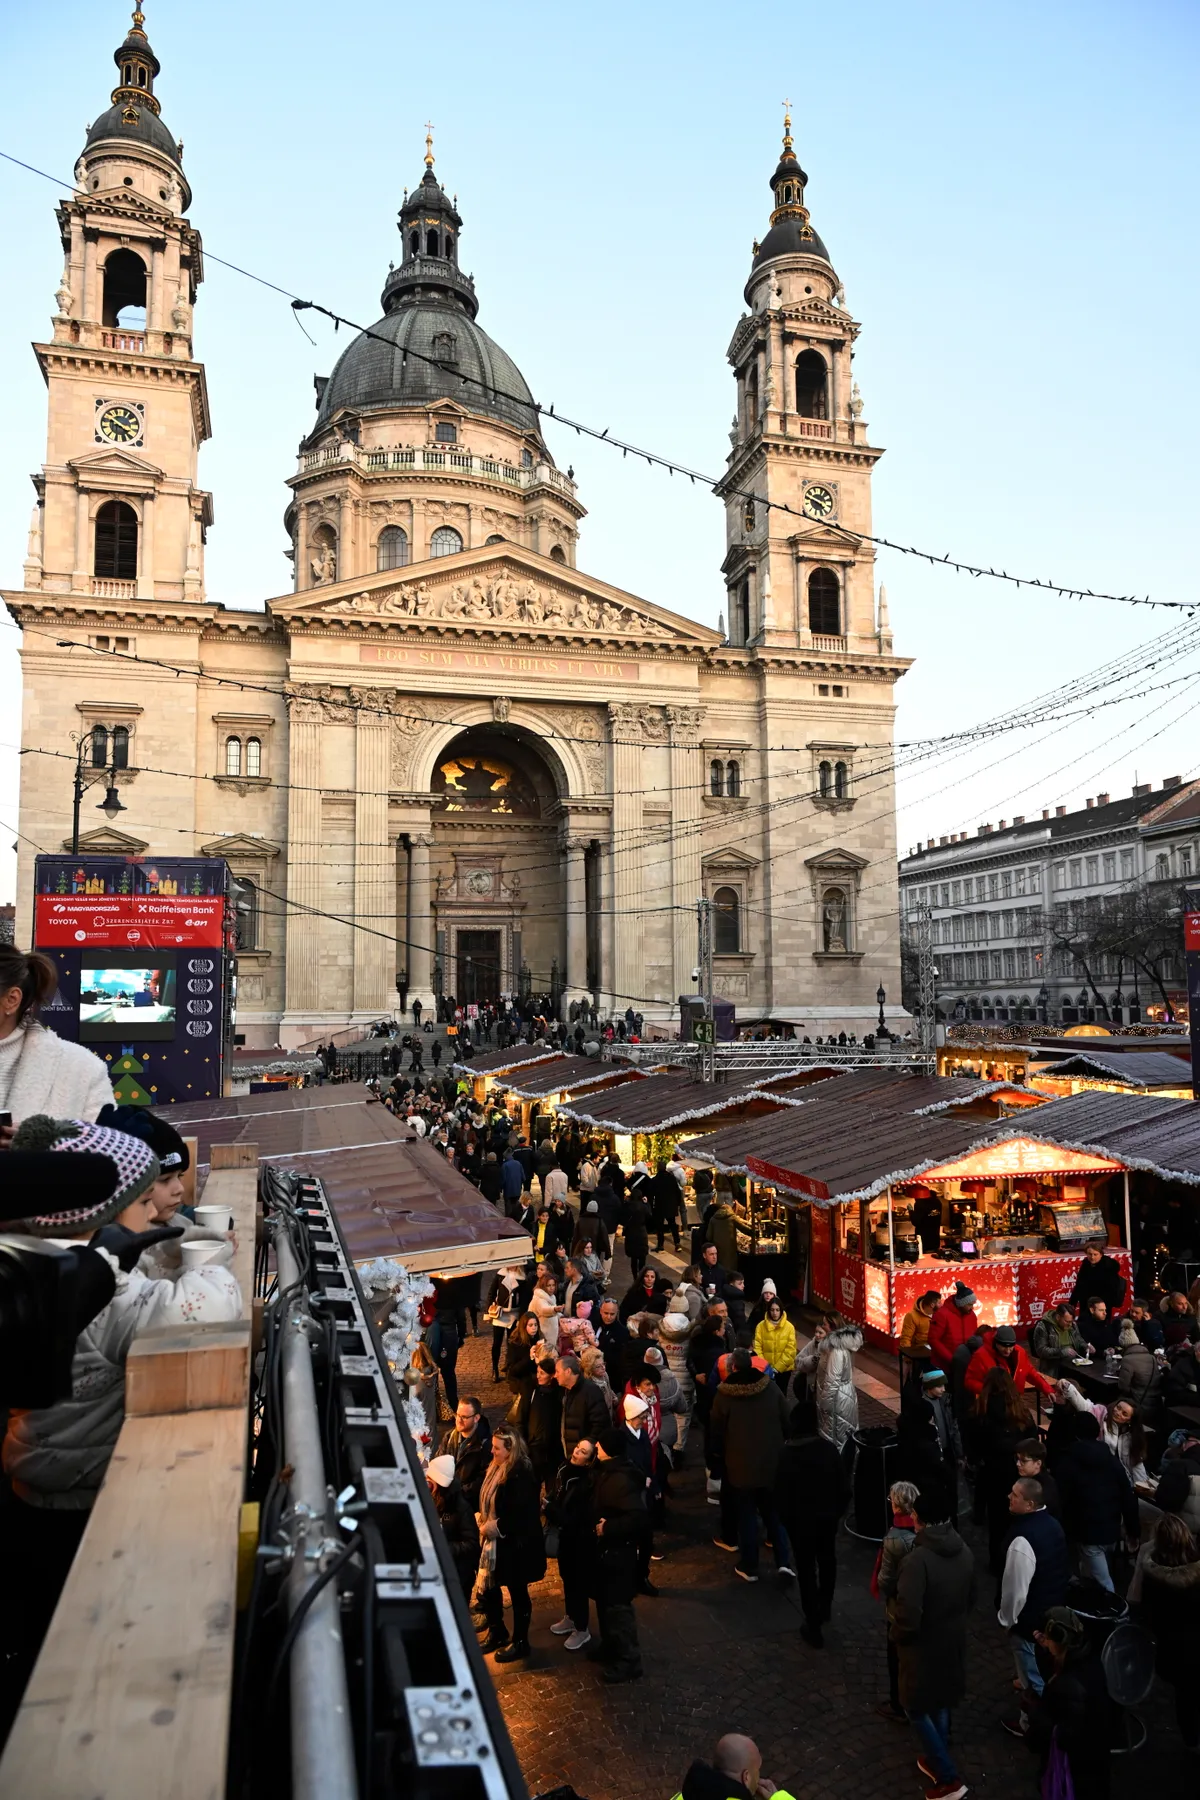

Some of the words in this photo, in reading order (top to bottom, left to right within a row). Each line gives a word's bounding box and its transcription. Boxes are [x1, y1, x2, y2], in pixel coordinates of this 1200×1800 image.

[377, 649, 408, 661] EGO
[420, 652, 453, 665] SUM
[464, 654, 489, 668] VIA
[499, 657, 559, 671] VERITAS
[568, 662, 584, 673] ET
[594, 663, 623, 676] VITA
[148, 905, 191, 914] Raiffeisen
[193, 906, 214, 914] Bank
